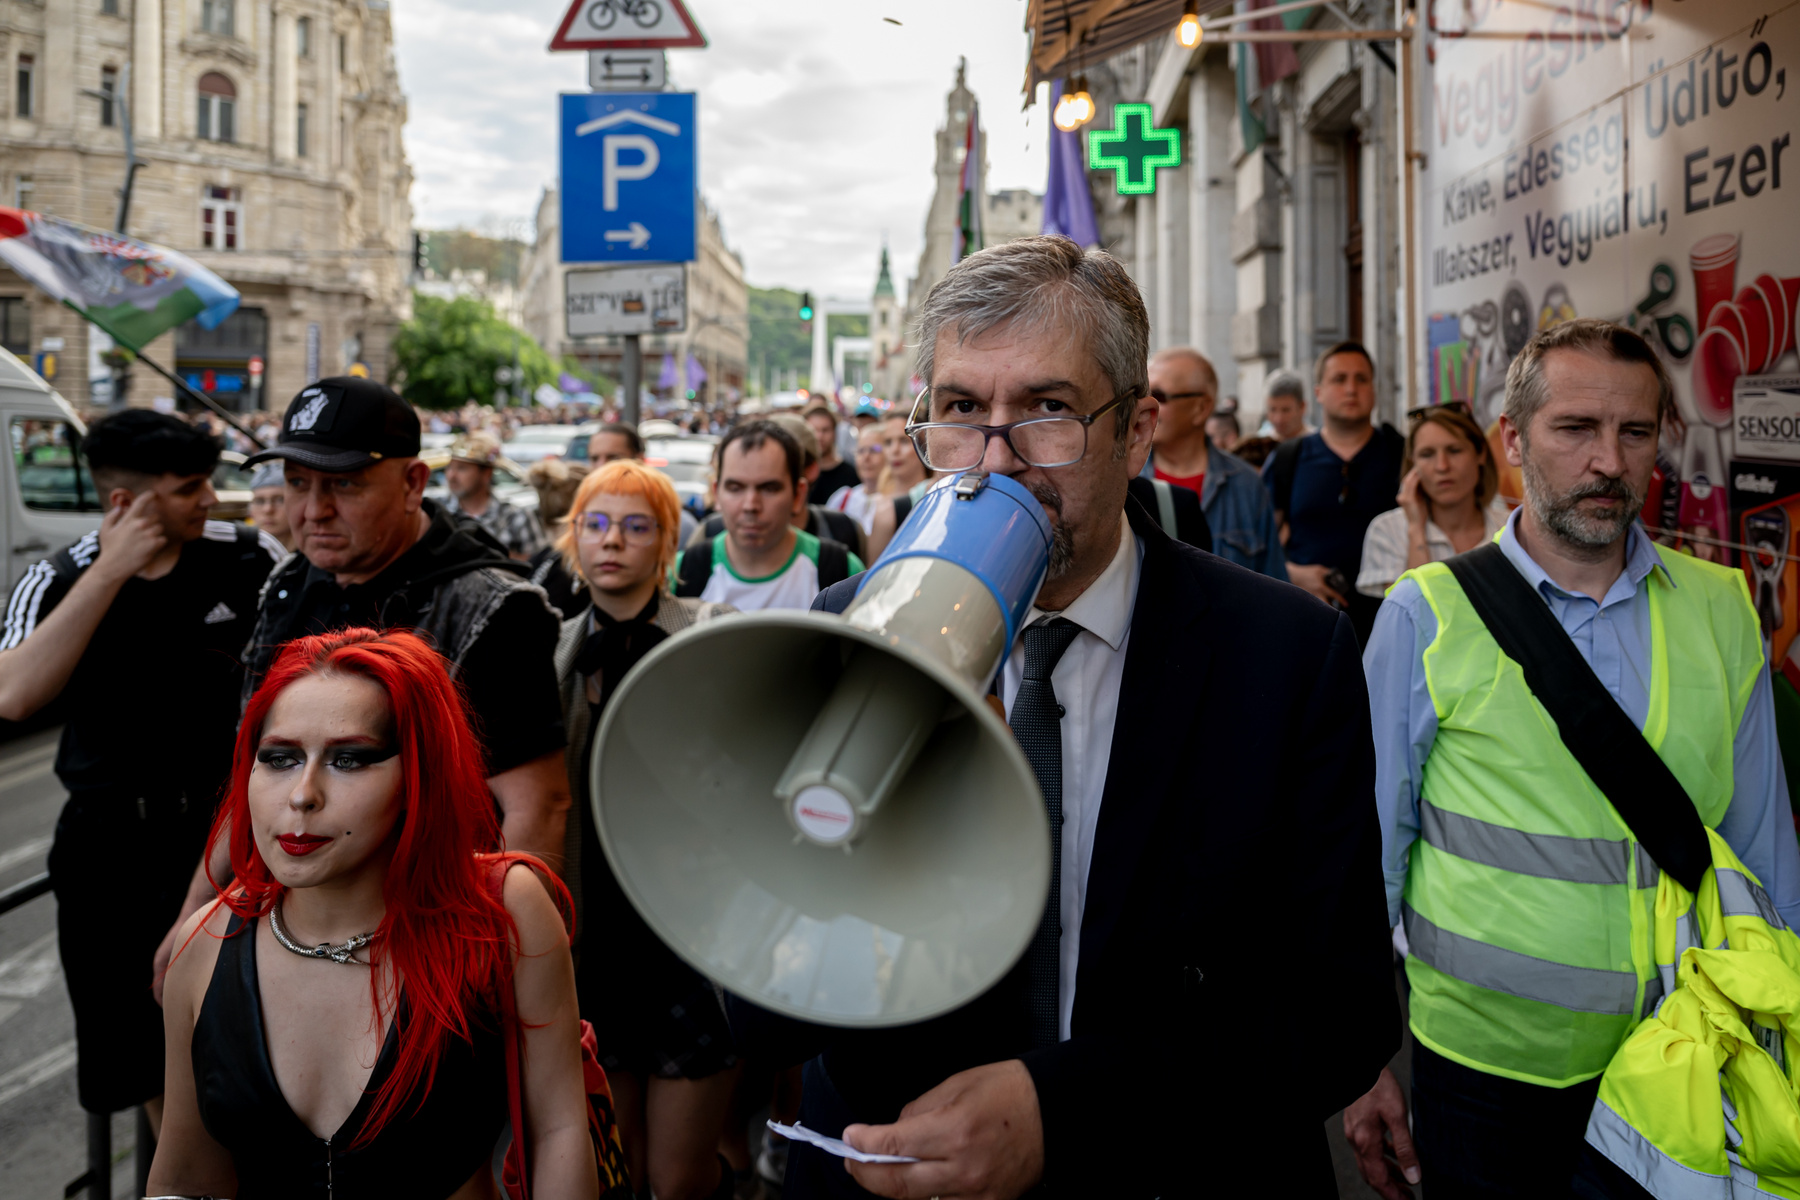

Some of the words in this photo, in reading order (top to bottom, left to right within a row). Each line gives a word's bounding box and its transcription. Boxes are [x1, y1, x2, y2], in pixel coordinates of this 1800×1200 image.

[1644, 14, 1786, 139] Üdítő,
[602, 134, 661, 212] P
[1432, 231, 1517, 287] Illatszer,
[1525, 177, 1668, 268] Vegyiáru,
[1684, 130, 1790, 215] Ezer
